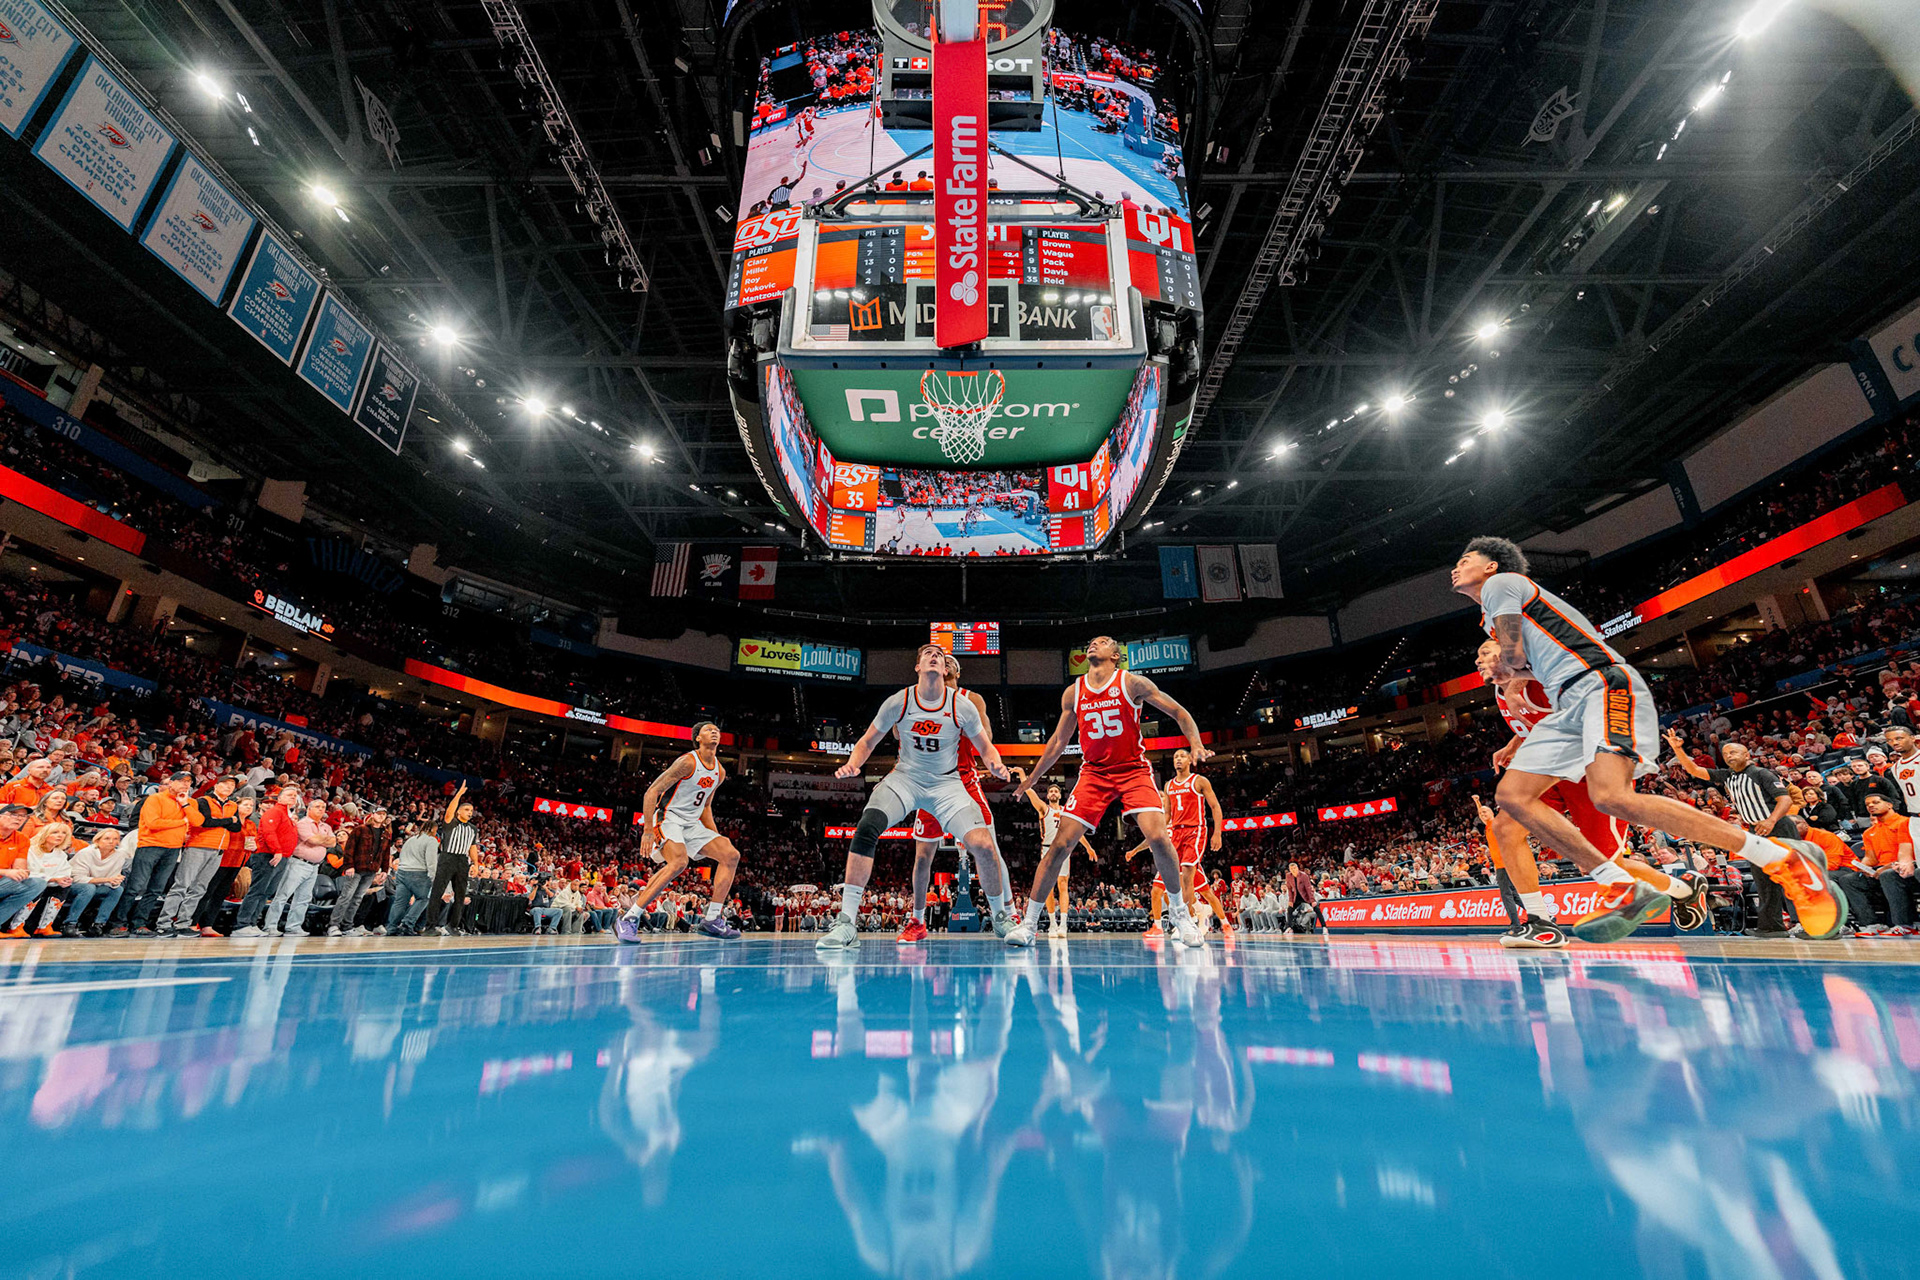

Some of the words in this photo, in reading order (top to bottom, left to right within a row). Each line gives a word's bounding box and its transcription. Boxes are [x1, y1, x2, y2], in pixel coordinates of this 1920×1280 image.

[35, 15, 62, 43] CITY
[95, 74, 145, 126] OKLAHOMA
[144, 121, 164, 144] CITY
[104, 99, 145, 144] THUNDER
[65, 126, 136, 191] NORTHWEST
[75, 123, 137, 181] 2023-2024
[59, 144, 127, 205] CHAMPIONS
[72, 144, 124, 190] DIVISION
[190, 167, 230, 211] OKLAHOMA
[229, 205, 245, 225] CITY
[197, 188, 231, 227] THUNDER
[165, 218, 223, 270] NORTHWEST
[173, 214, 223, 260] 2024-2025
[1042, 230, 1069, 240] PLAYER
[1042, 240, 1071, 249] Brown
[160, 234, 216, 284] CHAMPIONS
[170, 232, 212, 271] DIVISION
[747, 258, 768, 267] Clary
[748, 245, 773, 257] PLAYER
[1042, 249, 1074, 258] Wague
[1042, 258, 1065, 266] Pack
[1182, 254, 1191, 262] FLS
[267, 242, 300, 279] OKLAHOMA
[299, 273, 313, 291] CITY
[272, 262, 300, 294] THUNDER
[746, 266, 768, 275] Miller
[1043, 267, 1068, 276] Davis
[744, 277, 760, 285] Roy
[744, 282, 776, 293] Vukovic
[1043, 277, 1064, 285] Reid
[254, 294, 290, 329] WESTERN
[256, 287, 293, 322] 2011-2012
[244, 295, 293, 341] CONFERENCE
[244, 304, 288, 345] CHAMPIONS
[329, 303, 356, 335] OKLAHOMA
[355, 329, 367, 344] CITY
[334, 321, 356, 347] THUNDER
[311, 354, 352, 391] CONFERENCE
[318, 352, 348, 380] WESTERN
[310, 362, 347, 395] CHAMPIONS
[366, 405, 398, 435] CHAMPIONS
[378, 407, 390, 420] NBA
[909, 402, 1070, 422] pcom
[52, 415, 81, 441] 310
[912, 425, 1025, 440] ceer
[846, 491, 864, 508] 35
[1063, 491, 1080, 509] 41
[702, 553, 732, 565] THUNDER
[264, 594, 323, 632] BEDLAM
[274, 612, 309, 633] BASKETBALL
[442, 605, 460, 618] 312
[558, 639, 572, 650] 313
[1131, 645, 1159, 667] LOUD
[1163, 643, 1189, 661] CITY
[781, 669, 813, 677] THUNDER
[803, 650, 832, 667] LOUD
[834, 651, 859, 672] CITY
[1081, 698, 1121, 711] OKLAHOMA
[1302, 707, 1347, 726] BEDLAM
[1610, 688, 1630, 736] COWBOS
[911, 720, 942, 735] OSU
[1084, 708, 1124, 740] 35
[913, 735, 940, 752] 19
[693, 791, 706, 806] 9
[1905, 782, 1916, 796] 0
[1175, 795, 1184, 811] 1
[1329, 906, 1367, 921] StateFarm
[1384, 903, 1433, 920] StateFarm
[1456, 897, 1523, 917] StateFa
